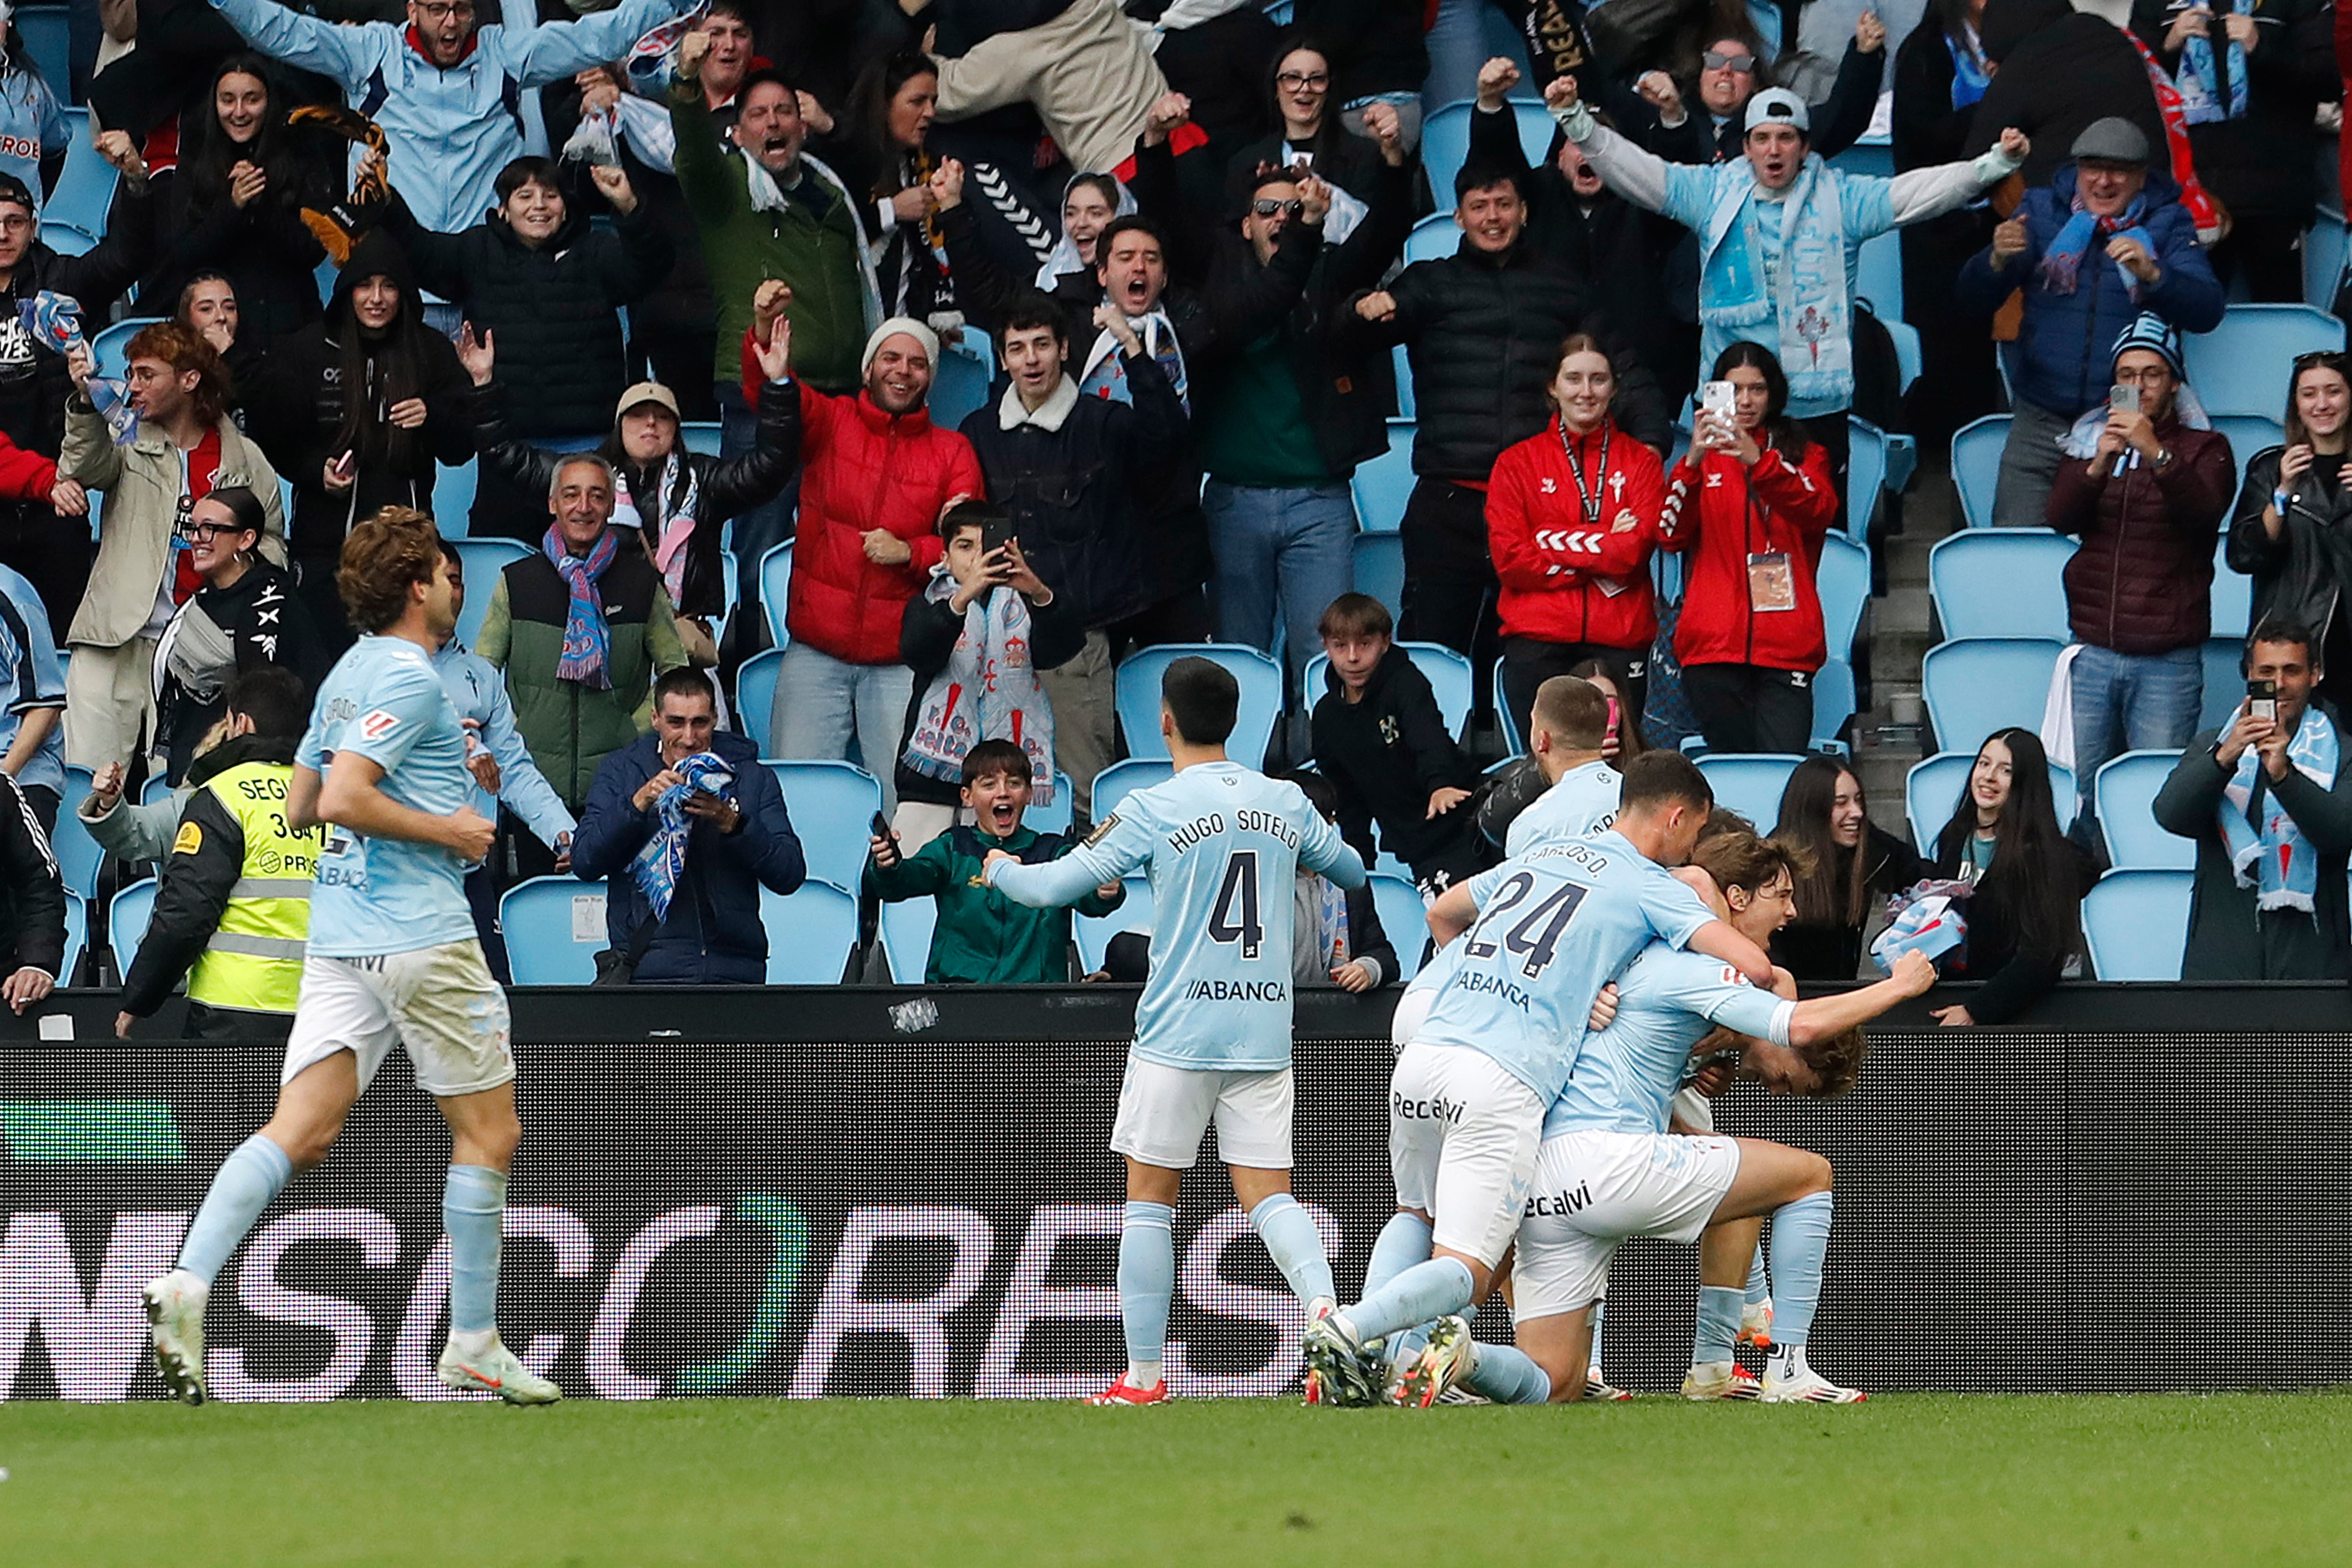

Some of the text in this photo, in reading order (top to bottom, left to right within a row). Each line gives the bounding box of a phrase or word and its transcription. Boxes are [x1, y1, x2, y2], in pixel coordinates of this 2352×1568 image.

[1168, 810, 1299, 855] HUGO SOTELO
[1207, 851, 1264, 959] 4
[1464, 871, 1589, 980] 24
[1394, 1091, 1467, 1125] Recalvi
[1524, 1179, 1594, 1218] ecalvi
